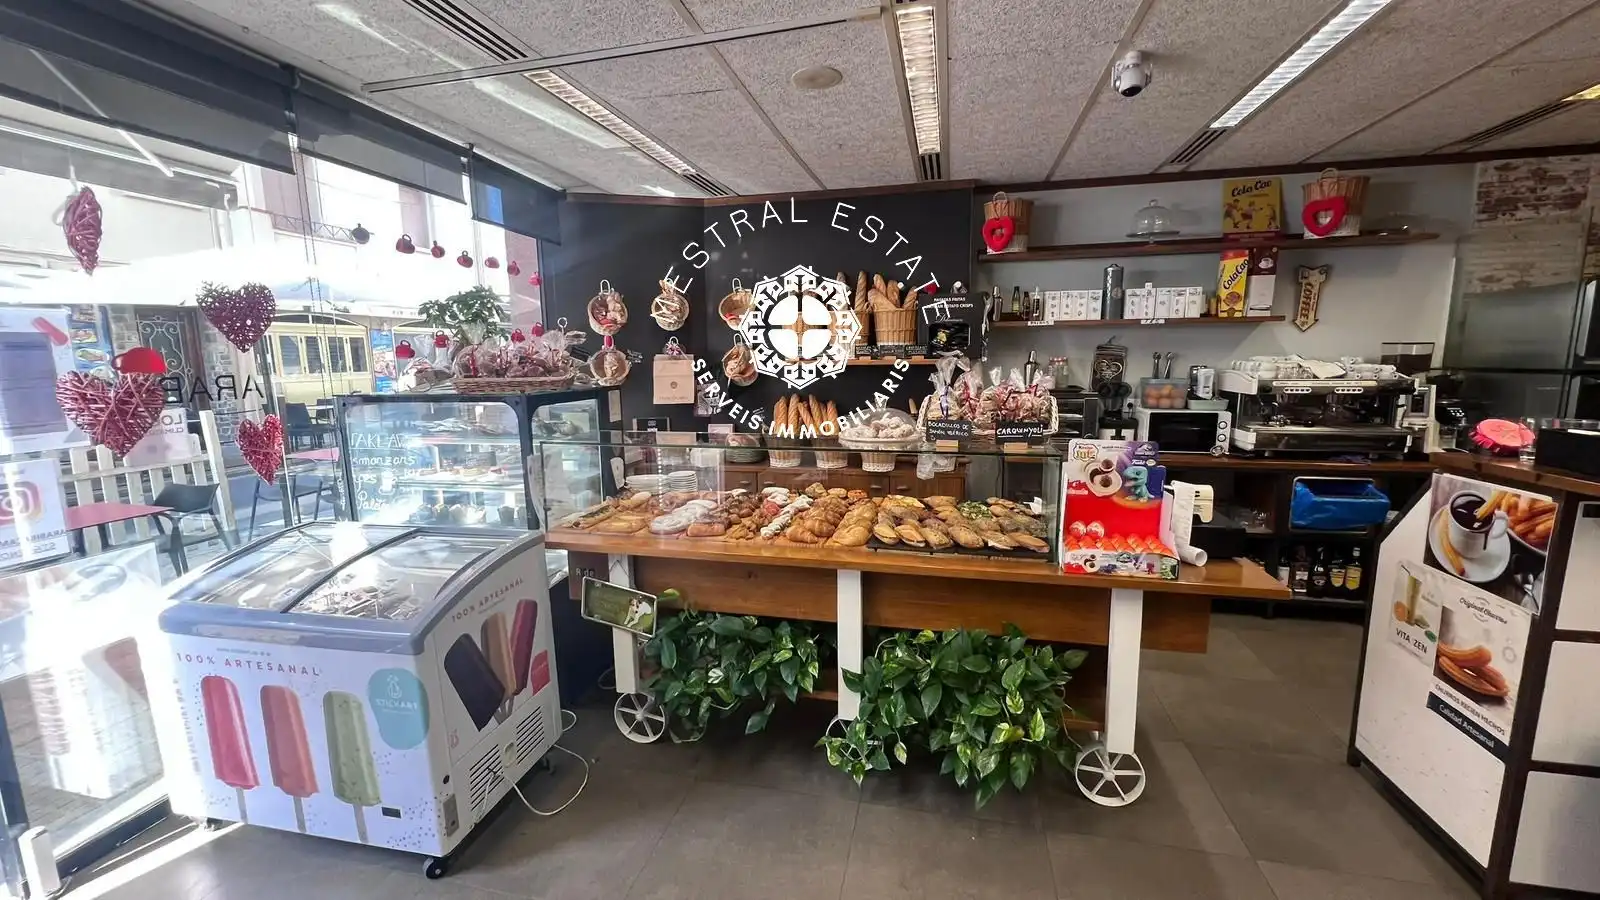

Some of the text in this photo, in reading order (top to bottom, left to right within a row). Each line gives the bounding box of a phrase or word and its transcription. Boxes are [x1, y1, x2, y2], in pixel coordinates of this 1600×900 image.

[1299, 281, 1314, 322] COFFEE
[1396, 627, 1411, 643] VITA
[1413, 639, 1428, 655] ZEN
[177, 652, 320, 677] 100% ARTESANAL
[1439, 704, 1495, 748] Calidad Artesanal
